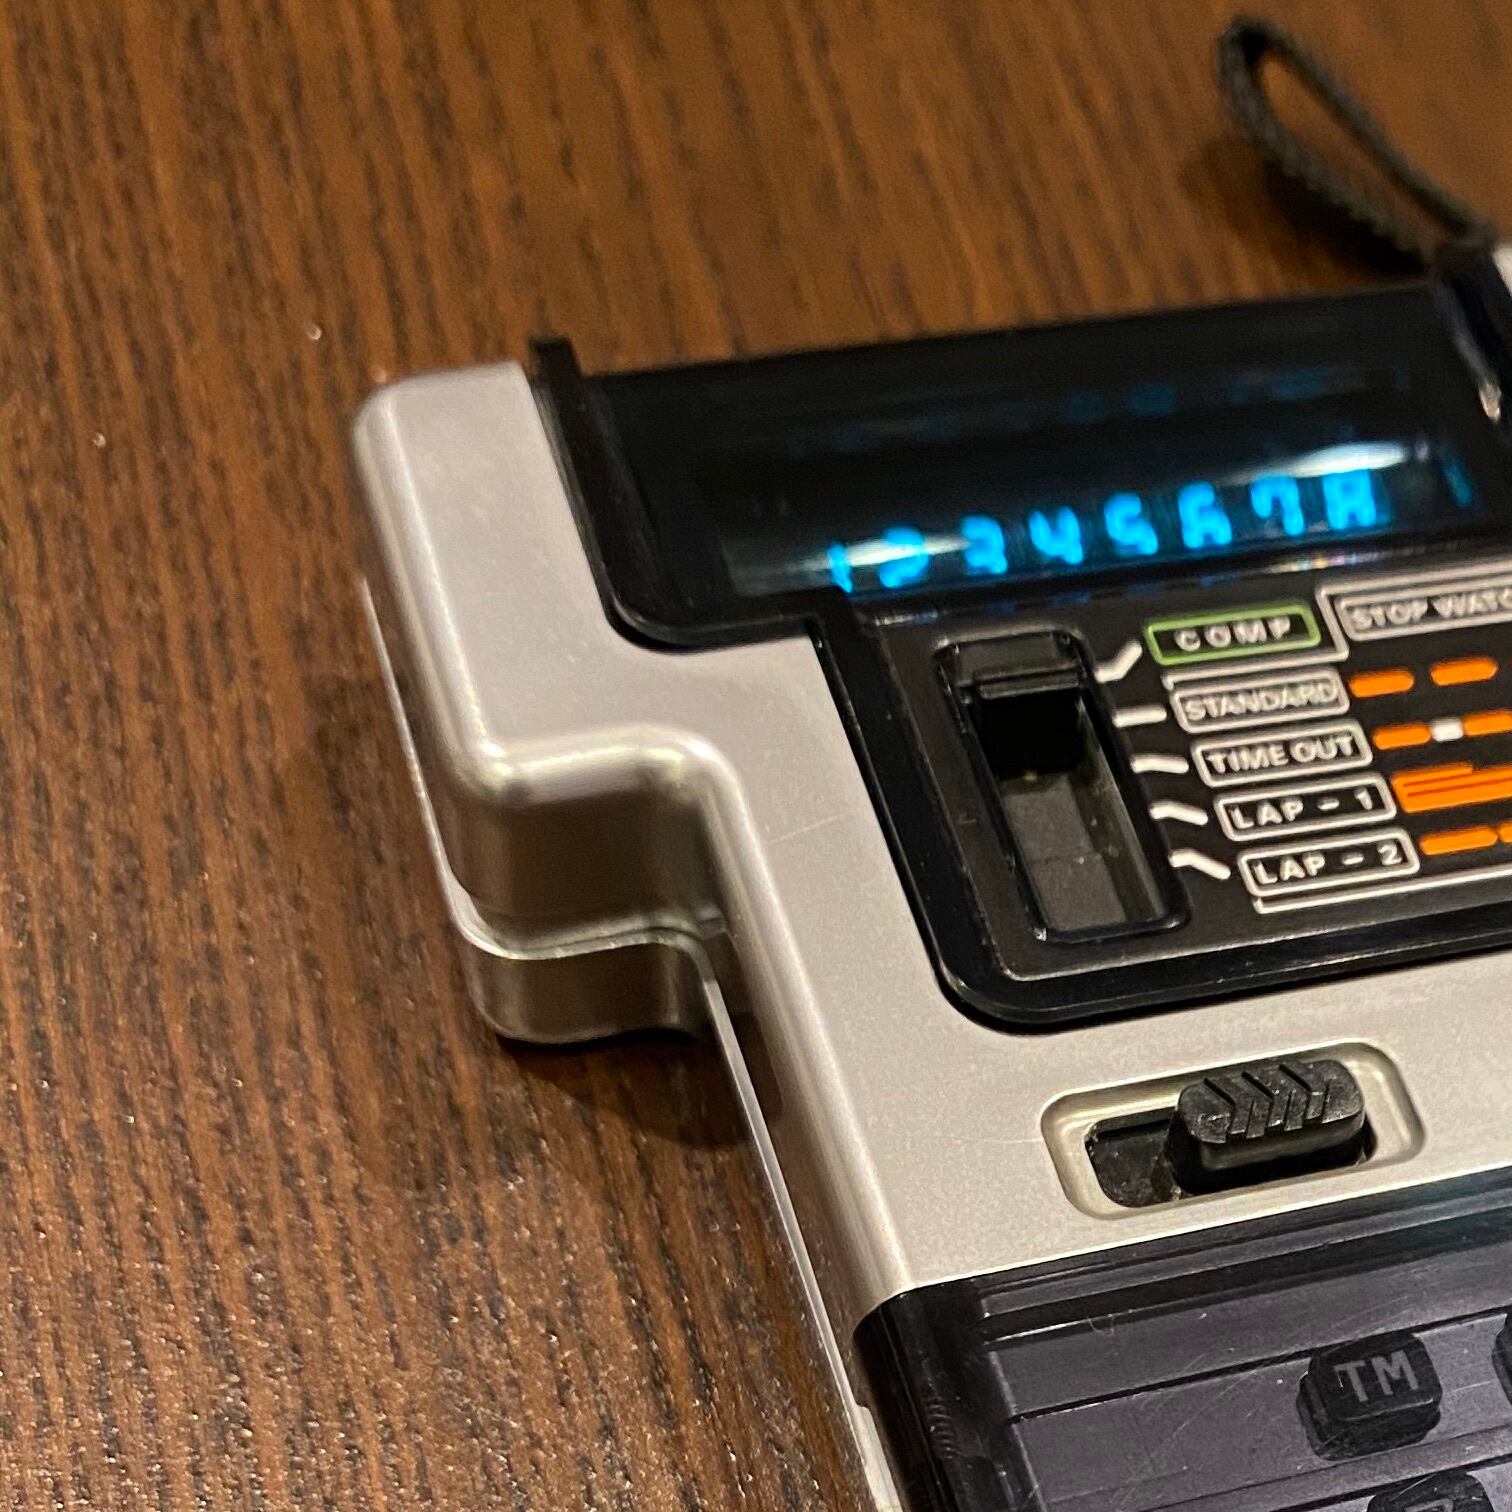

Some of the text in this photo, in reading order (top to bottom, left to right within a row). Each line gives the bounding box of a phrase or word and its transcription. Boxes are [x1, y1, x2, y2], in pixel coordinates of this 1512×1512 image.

[1173, 616, 1291, 651] COMP
[1351, 600, 1430, 630] STOP
[1184, 681, 1338, 721] STANDARD
[1208, 735, 1355, 773] TIME OUT
[1231, 799, 1305, 829] LAP
[1251, 852, 1327, 885] LAP
[1377, 845, 1403, 868] 2
[1332, 1351, 1423, 1403] TM
